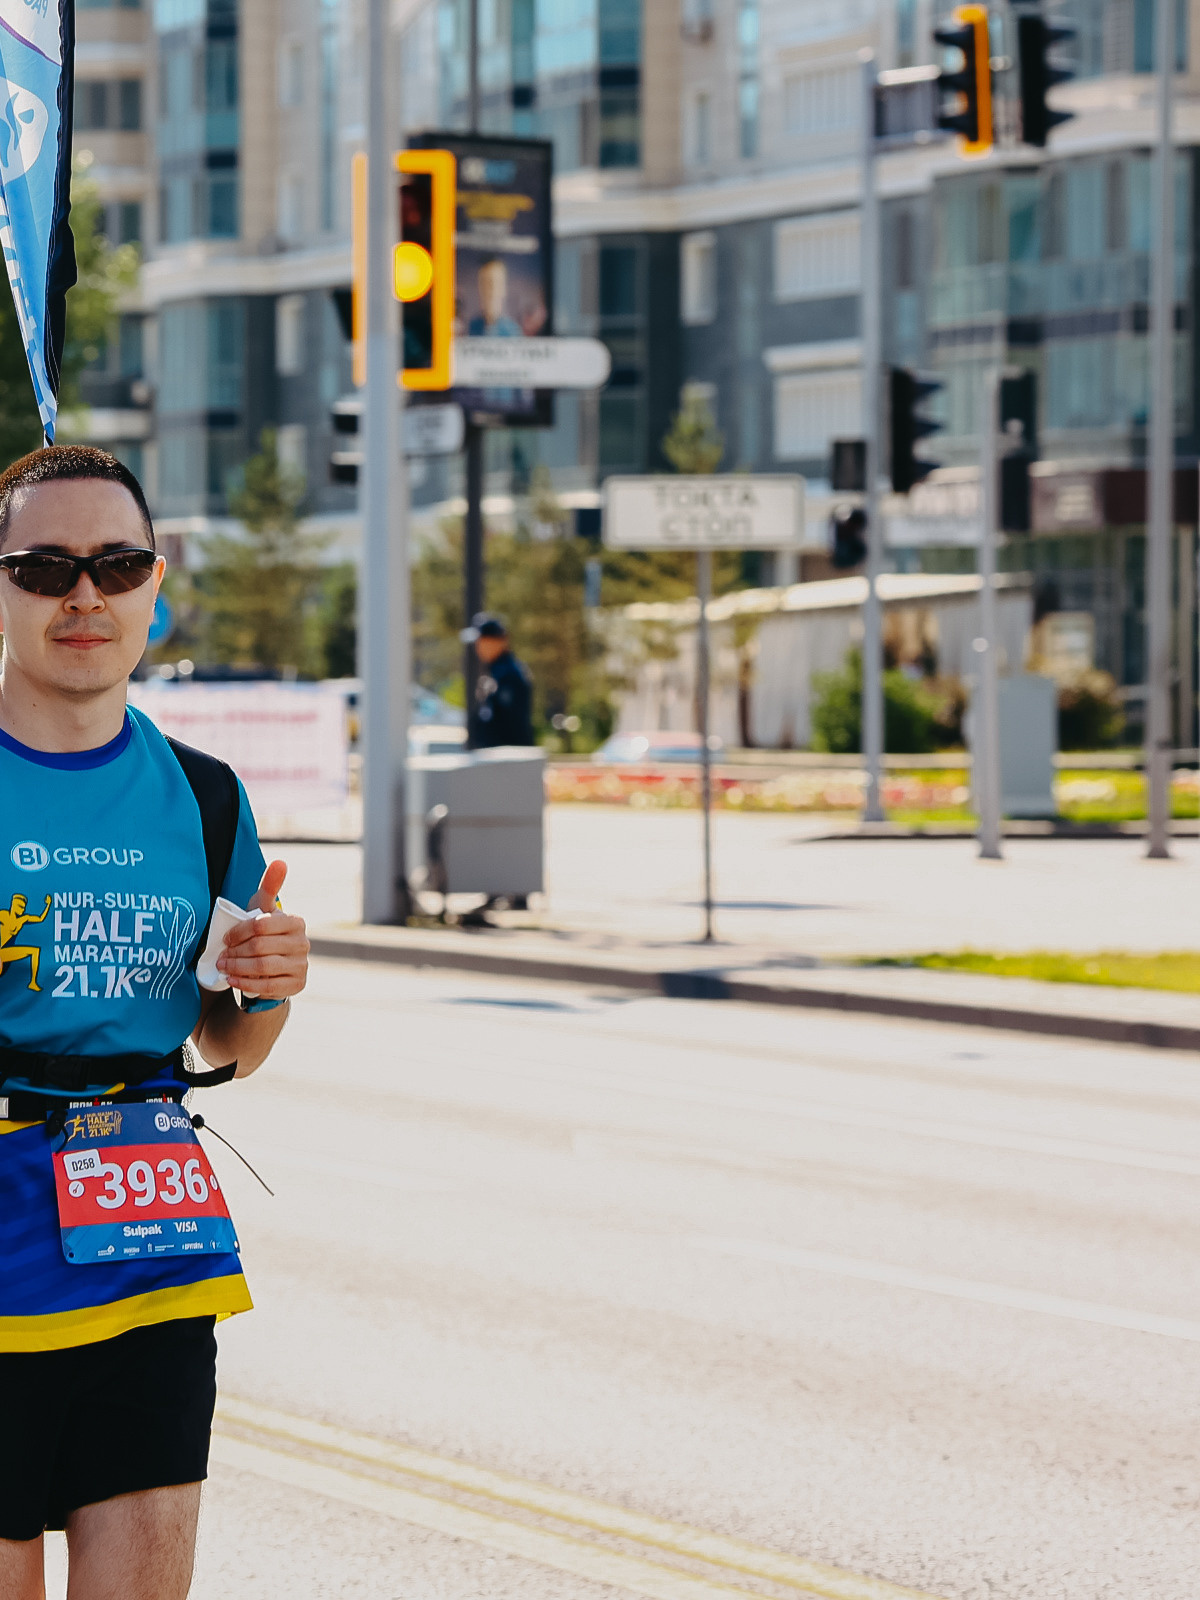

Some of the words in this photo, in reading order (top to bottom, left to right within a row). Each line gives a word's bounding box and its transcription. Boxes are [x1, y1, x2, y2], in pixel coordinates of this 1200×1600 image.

[16, 845, 44, 868] BI
[53, 847, 144, 867] GROUP
[53, 891, 173, 912] NUR-SULTAN
[54, 910, 155, 943] HALF
[54, 944, 172, 966] MARATHON
[87, 1115, 110, 1125] HALF
[171, 1116, 193, 1130] GROU
[71, 1157, 95, 1172] D258
[96, 1158, 209, 1209] 3936
[123, 1224, 162, 1238] Sulpak
[174, 1220, 198, 1233] VISA
